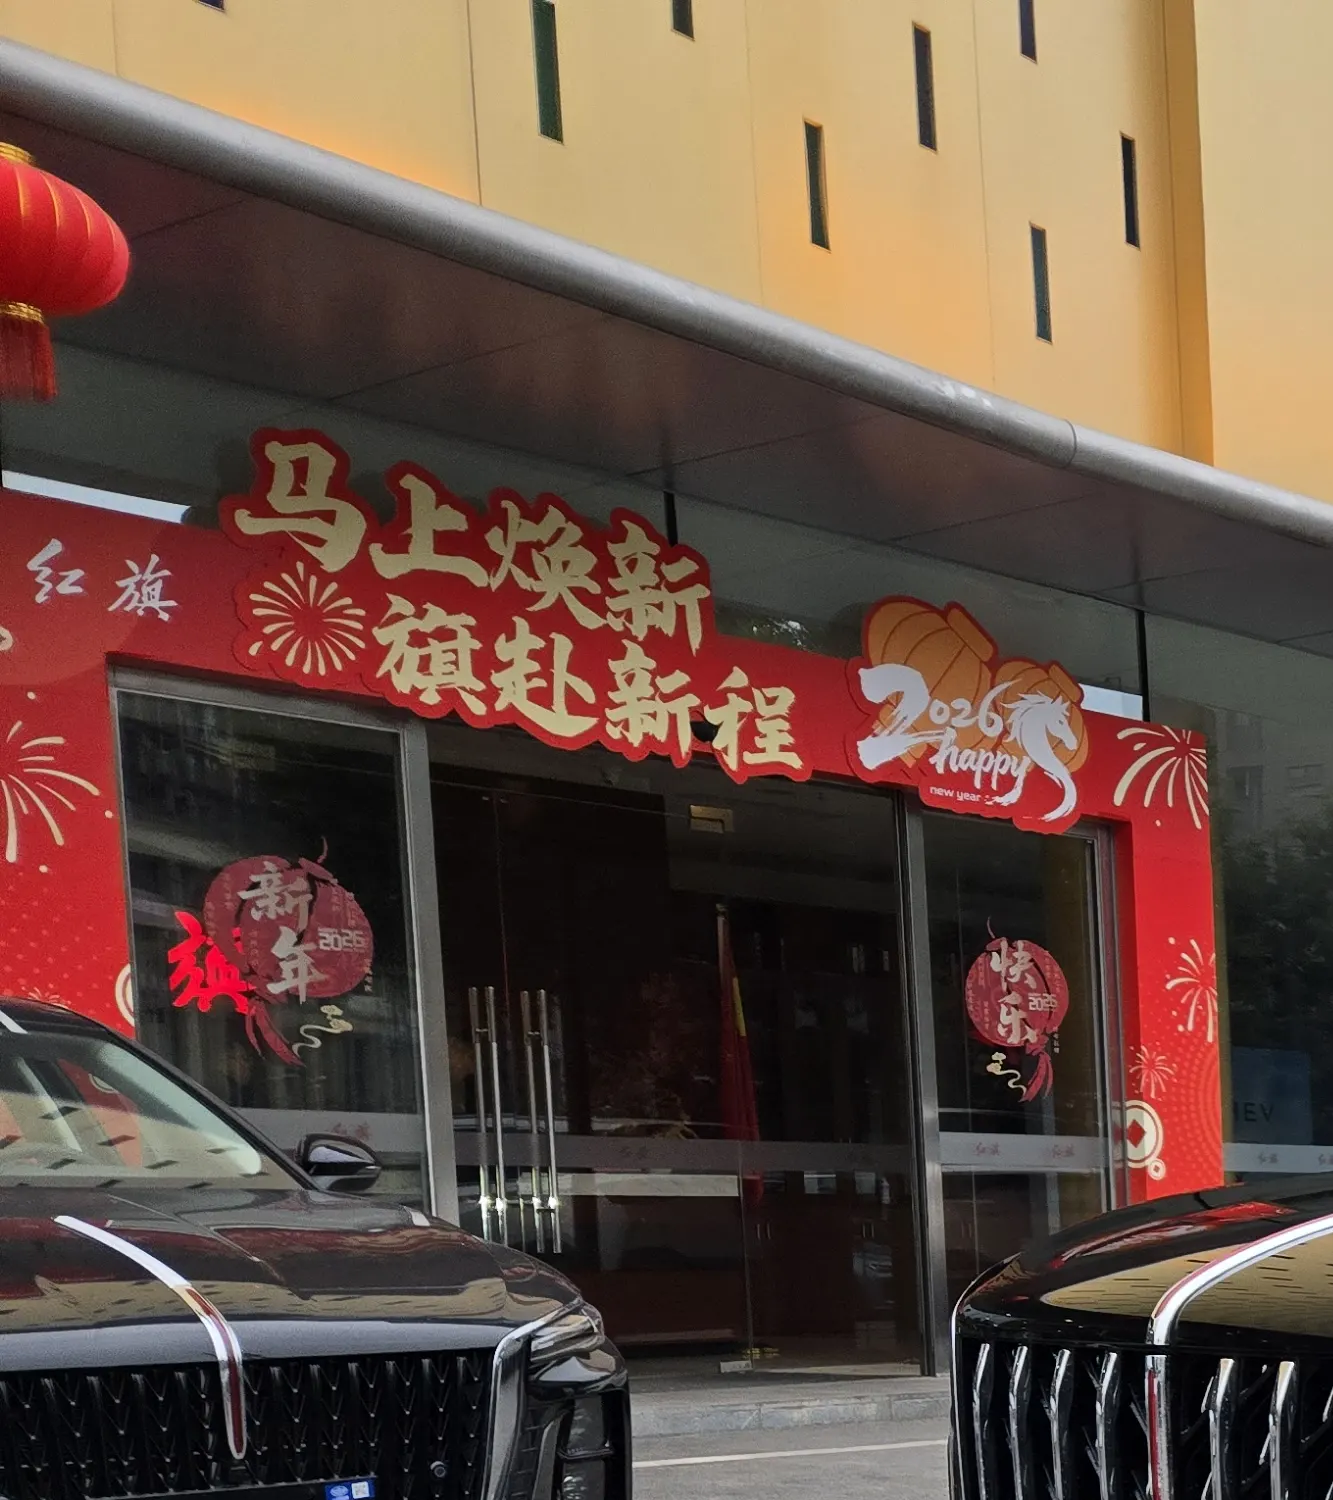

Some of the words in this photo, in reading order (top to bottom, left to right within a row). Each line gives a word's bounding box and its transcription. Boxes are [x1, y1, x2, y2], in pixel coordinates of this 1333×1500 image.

[26, 538, 180, 622] 红旗
[233, 440, 711, 656] 马上焕新
[371, 592, 804, 773] 旗赴新程
[856, 662, 1023, 770] 2026
[929, 726, 1032, 807] happy
[929, 785, 956, 797] new
[956, 789, 982, 803] year
[236, 860, 330, 1005] 新年
[989, 936, 1039, 1045] 快乐
